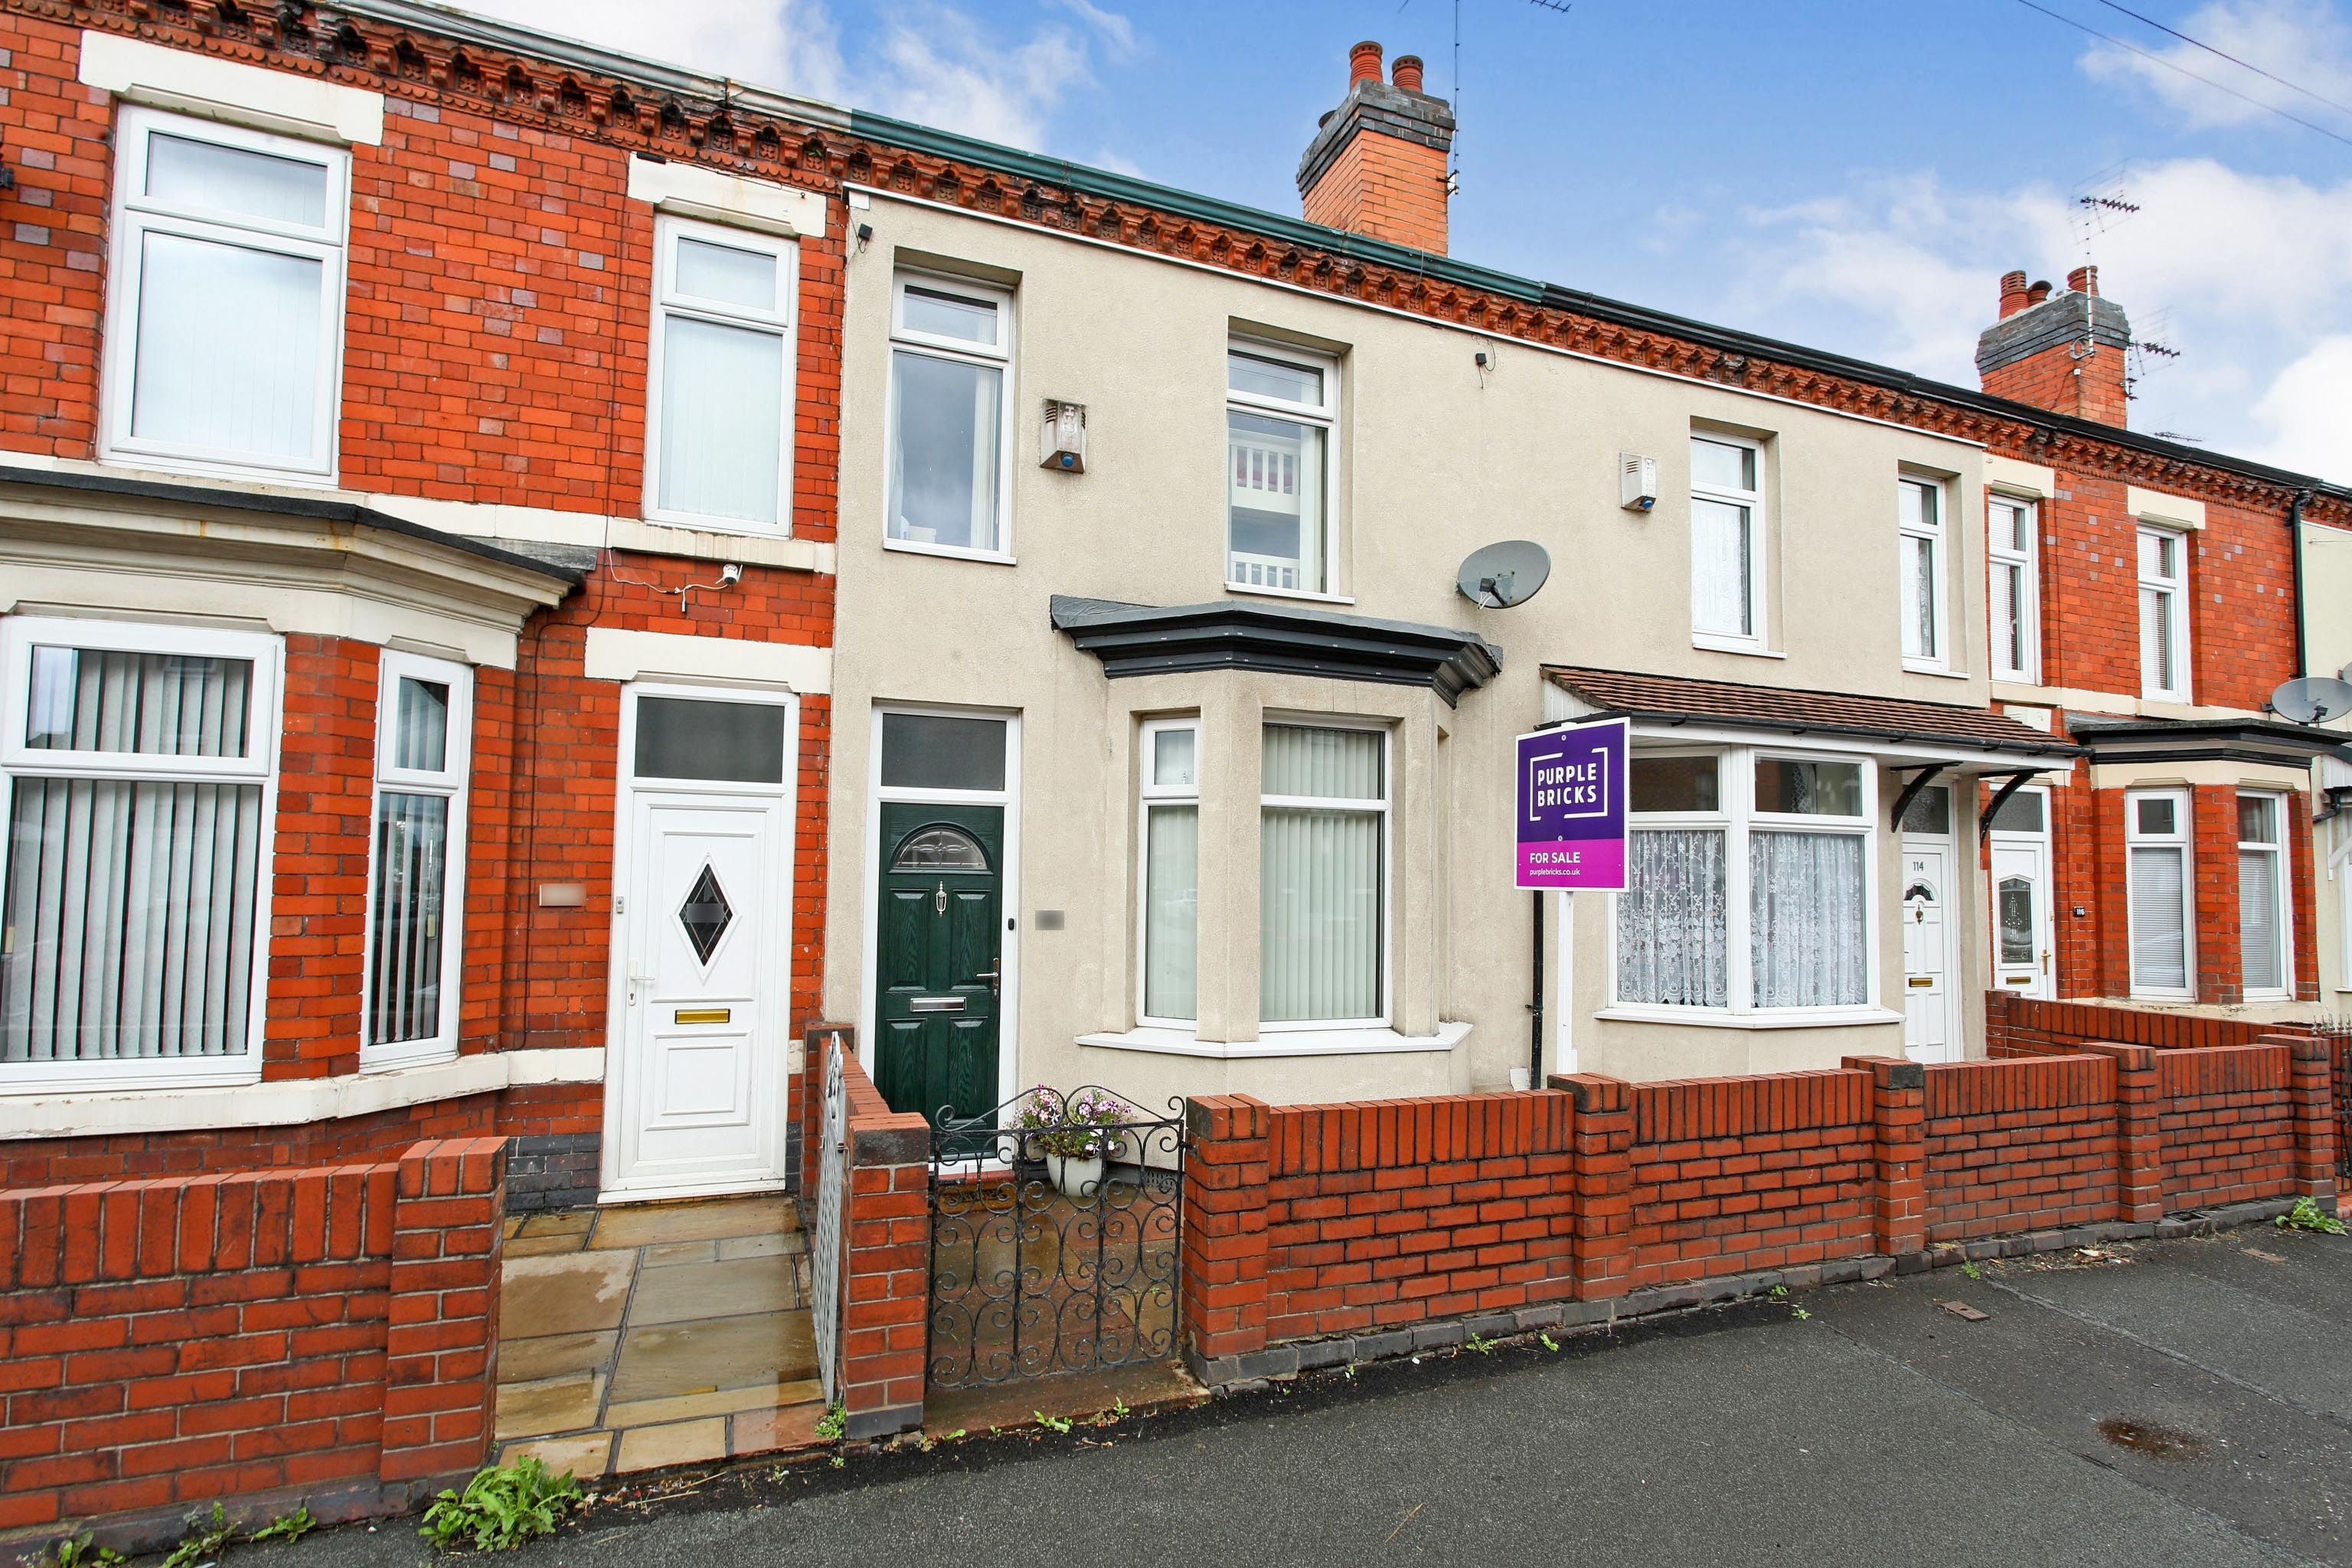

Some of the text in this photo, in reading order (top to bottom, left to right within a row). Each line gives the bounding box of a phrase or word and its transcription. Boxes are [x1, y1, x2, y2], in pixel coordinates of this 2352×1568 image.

[1537, 763, 1597, 786] PURPLE
[1537, 785, 1597, 807] BRICKS
[1530, 851, 1581, 864] FOR SALE
[1529, 867, 1581, 877] purplebricks.co.uk
[1913, 861, 1924, 871] 114
